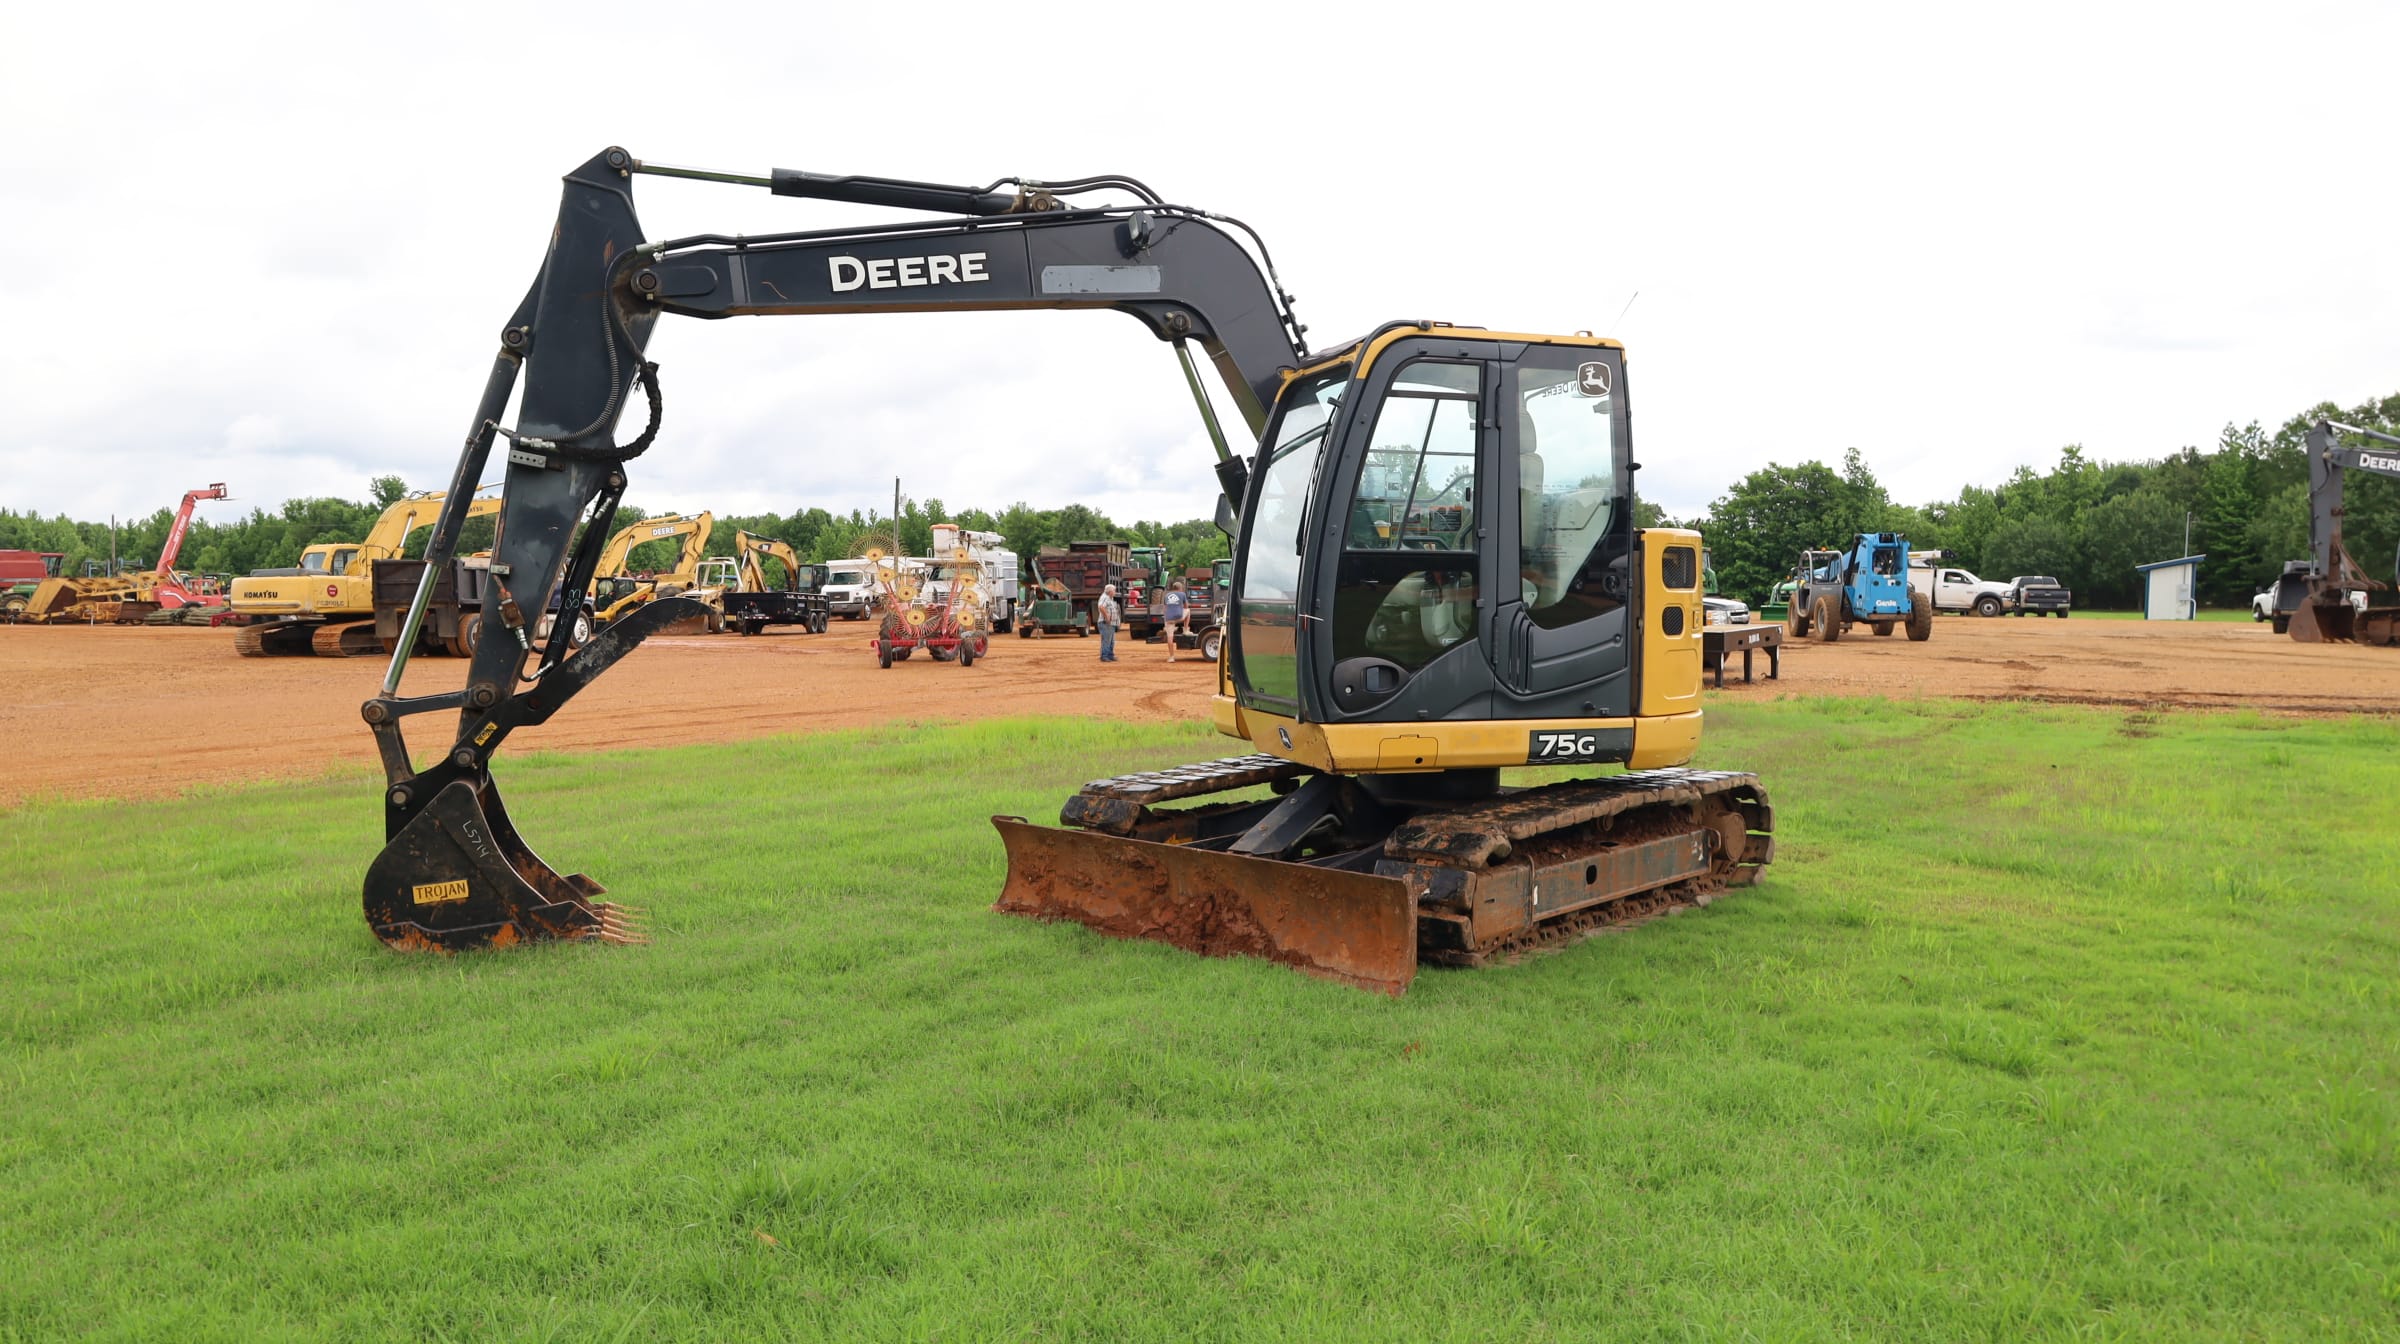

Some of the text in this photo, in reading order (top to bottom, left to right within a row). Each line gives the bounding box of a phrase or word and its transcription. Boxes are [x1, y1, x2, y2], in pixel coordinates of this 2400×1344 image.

[828, 252, 990, 292] DEERE
[652, 526, 676, 536] DEERE
[243, 589, 279, 599] KOMATSU
[1538, 734, 1596, 757] 75G
[462, 819, 491, 858] L5714
[415, 882, 467, 900] TROJAN
